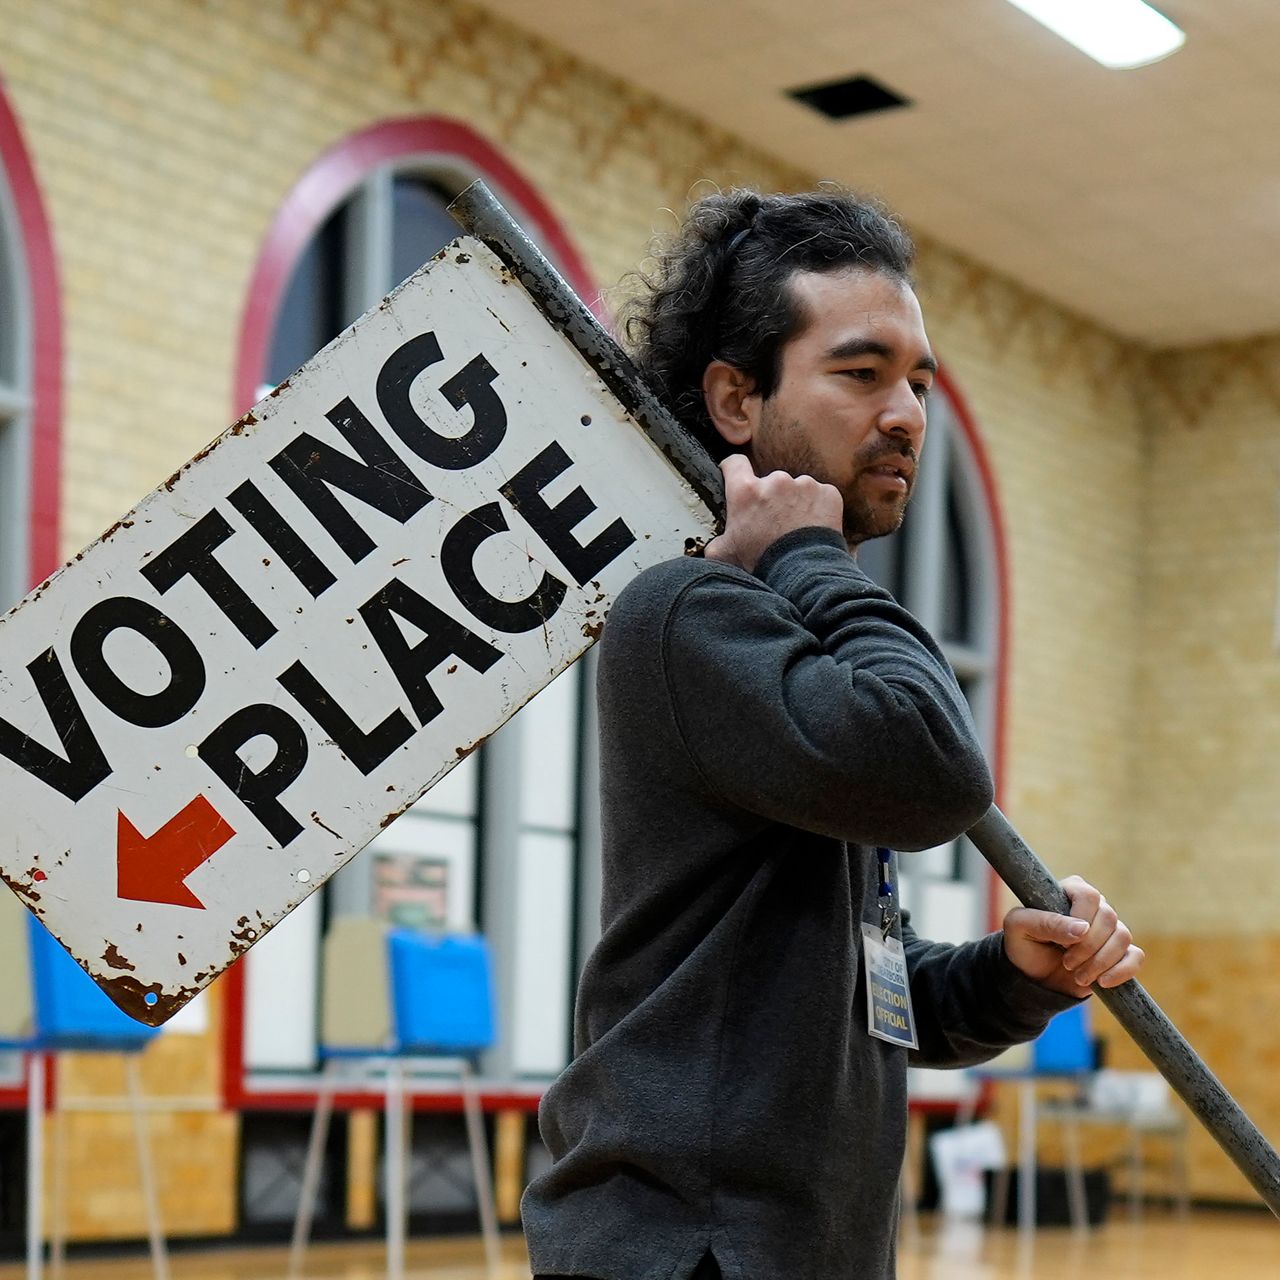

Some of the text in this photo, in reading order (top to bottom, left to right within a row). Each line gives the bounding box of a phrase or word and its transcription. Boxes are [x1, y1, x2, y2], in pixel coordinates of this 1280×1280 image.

[198, 441, 637, 848] PLACE
[895, 962, 903, 974] OF
[872, 982, 907, 1009] ELECTION
[875, 1006, 908, 1030] OFFICIAL
